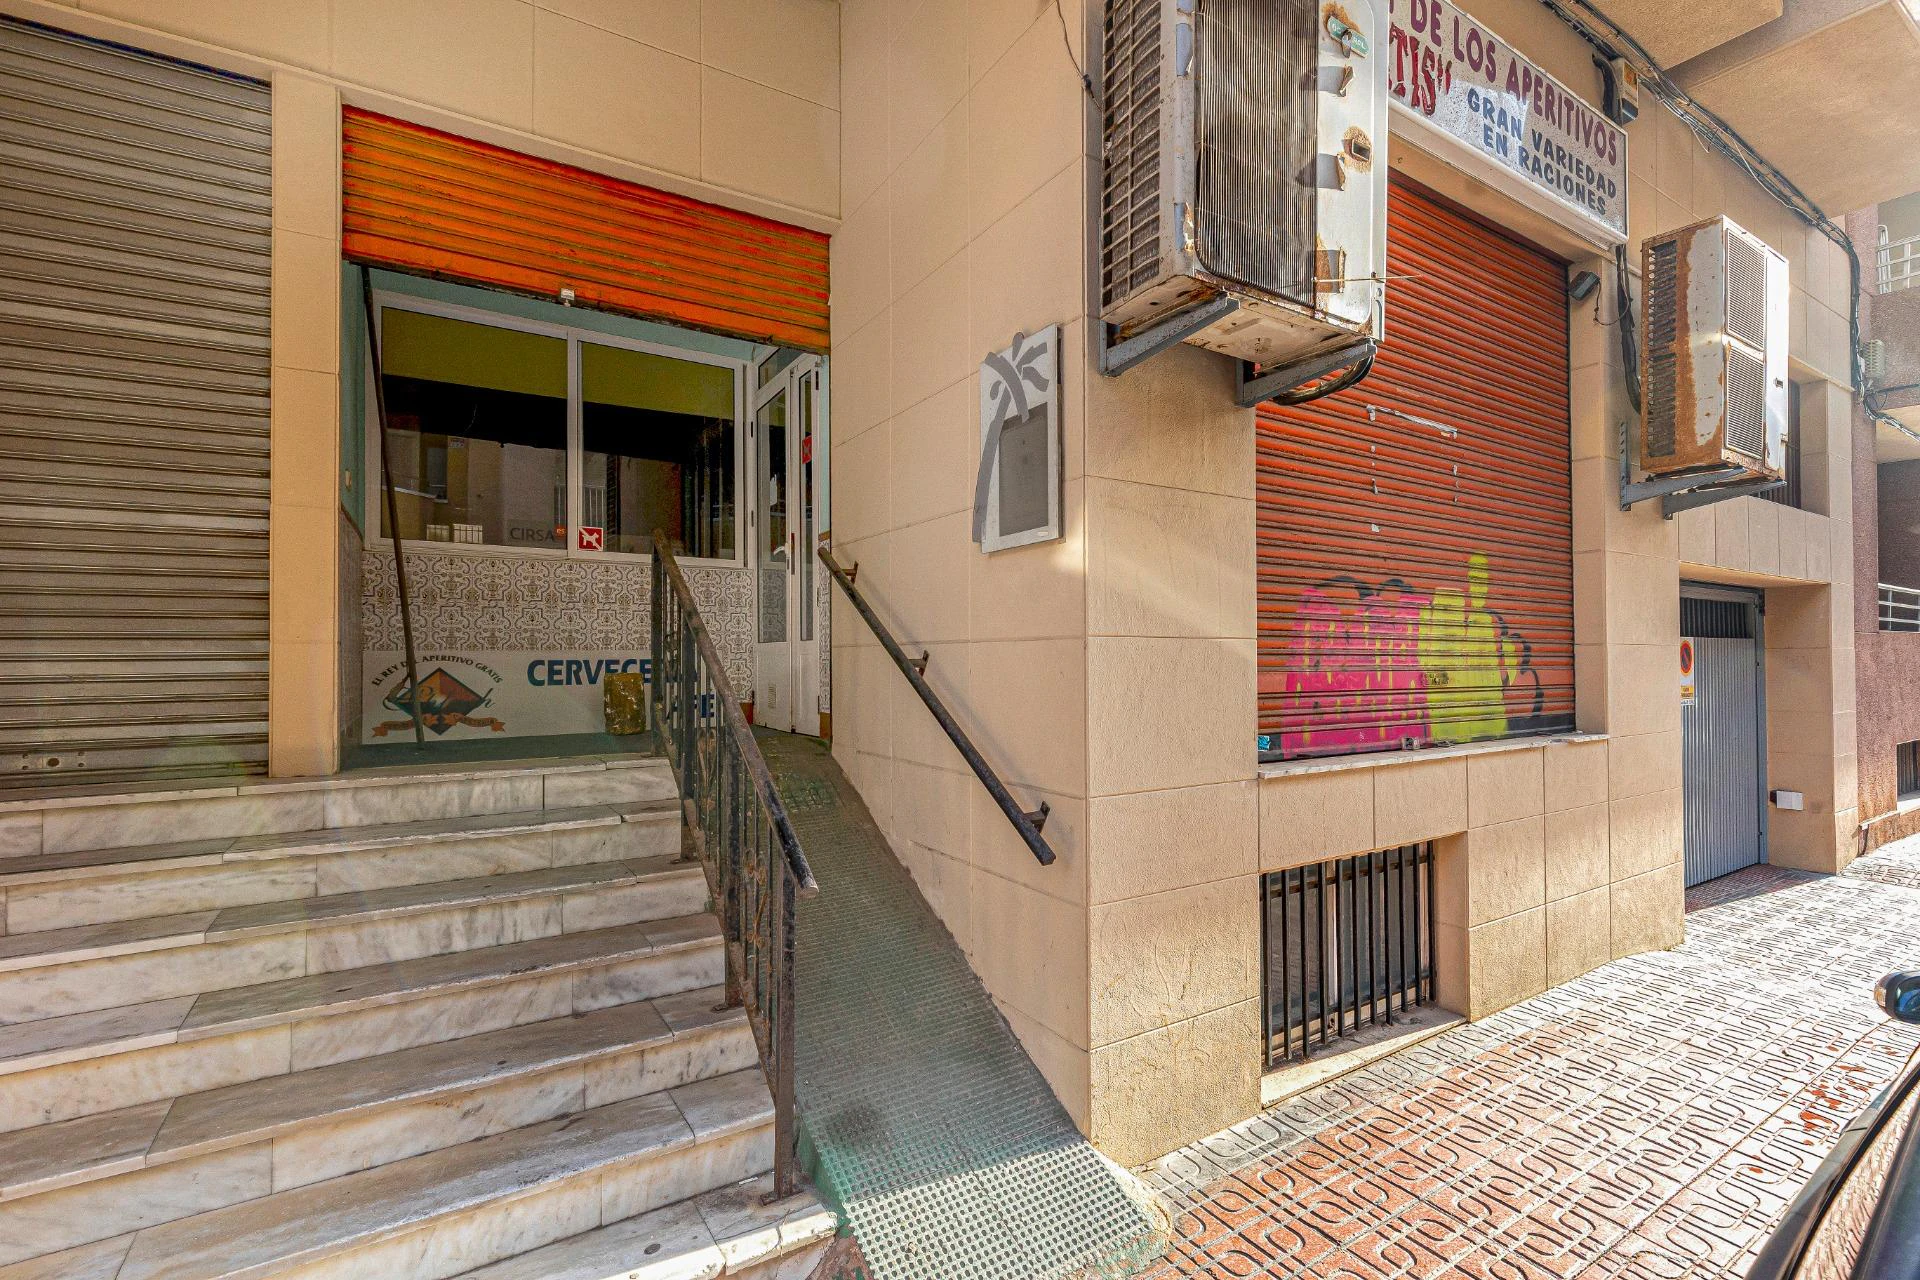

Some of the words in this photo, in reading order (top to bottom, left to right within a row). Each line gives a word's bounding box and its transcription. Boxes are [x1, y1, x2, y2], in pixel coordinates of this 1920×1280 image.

[1411, 0, 1442, 47] DE
[1454, 15, 1496, 84] LOS
[1505, 57, 1617, 167] APERITIVOS
[1467, 88, 1522, 142] GRAN
[1531, 128, 1617, 200] VARIEDAD
[1483, 124, 1508, 158] EN
[1518, 146, 1606, 216] RACIONES
[509, 527, 554, 542] CIRSA
[371, 679, 383, 687] EL
[380, 664, 399, 678] REY
[421, 655, 474, 666] APERITIVO
[475, 661, 504, 684] GRATIS
